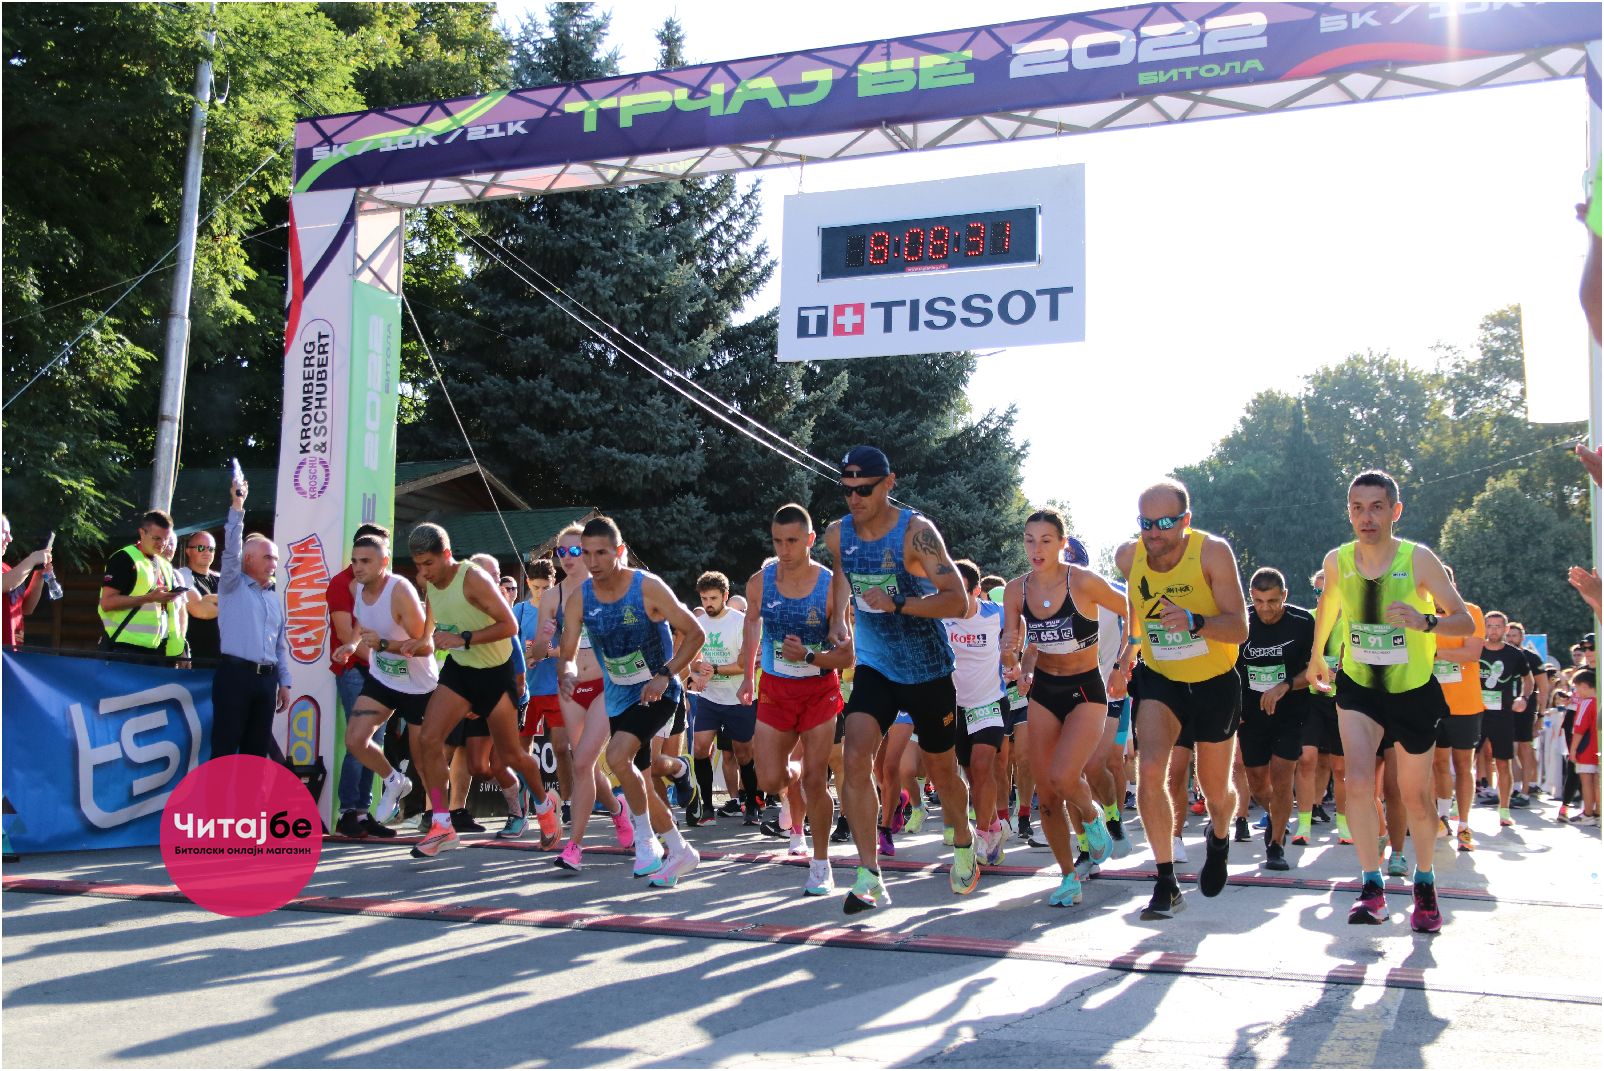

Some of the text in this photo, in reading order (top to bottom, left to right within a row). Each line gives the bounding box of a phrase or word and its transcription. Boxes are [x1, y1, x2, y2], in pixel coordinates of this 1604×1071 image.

[1319, 10, 1382, 33] 5K
[564, 11, 1268, 132] ТРЧАЈ БЕ 2022
[1137, 59, 1265, 86] БИТОЛА
[312, 140, 351, 162] 5K
[379, 133, 440, 154] 10K
[466, 120, 529, 142] 21K
[869, 221, 1011, 265] 8:08:31
[870, 285, 1074, 334] TISSOT
[299, 340, 317, 455] KROMBERG
[313, 331, 330, 455] & SCHUBERT
[363, 314, 385, 471] 2022
[308, 456, 318, 500] KROSCHU
[286, 536, 328, 662] CEVITANA
[1041, 630, 1059, 641] 653
[1164, 633, 1183, 644] 90
[1250, 647, 1283, 657] NIKE
[1367, 636, 1383, 647] 91
[1260, 673, 1273, 682] 86
[974, 707, 990, 719] 103
